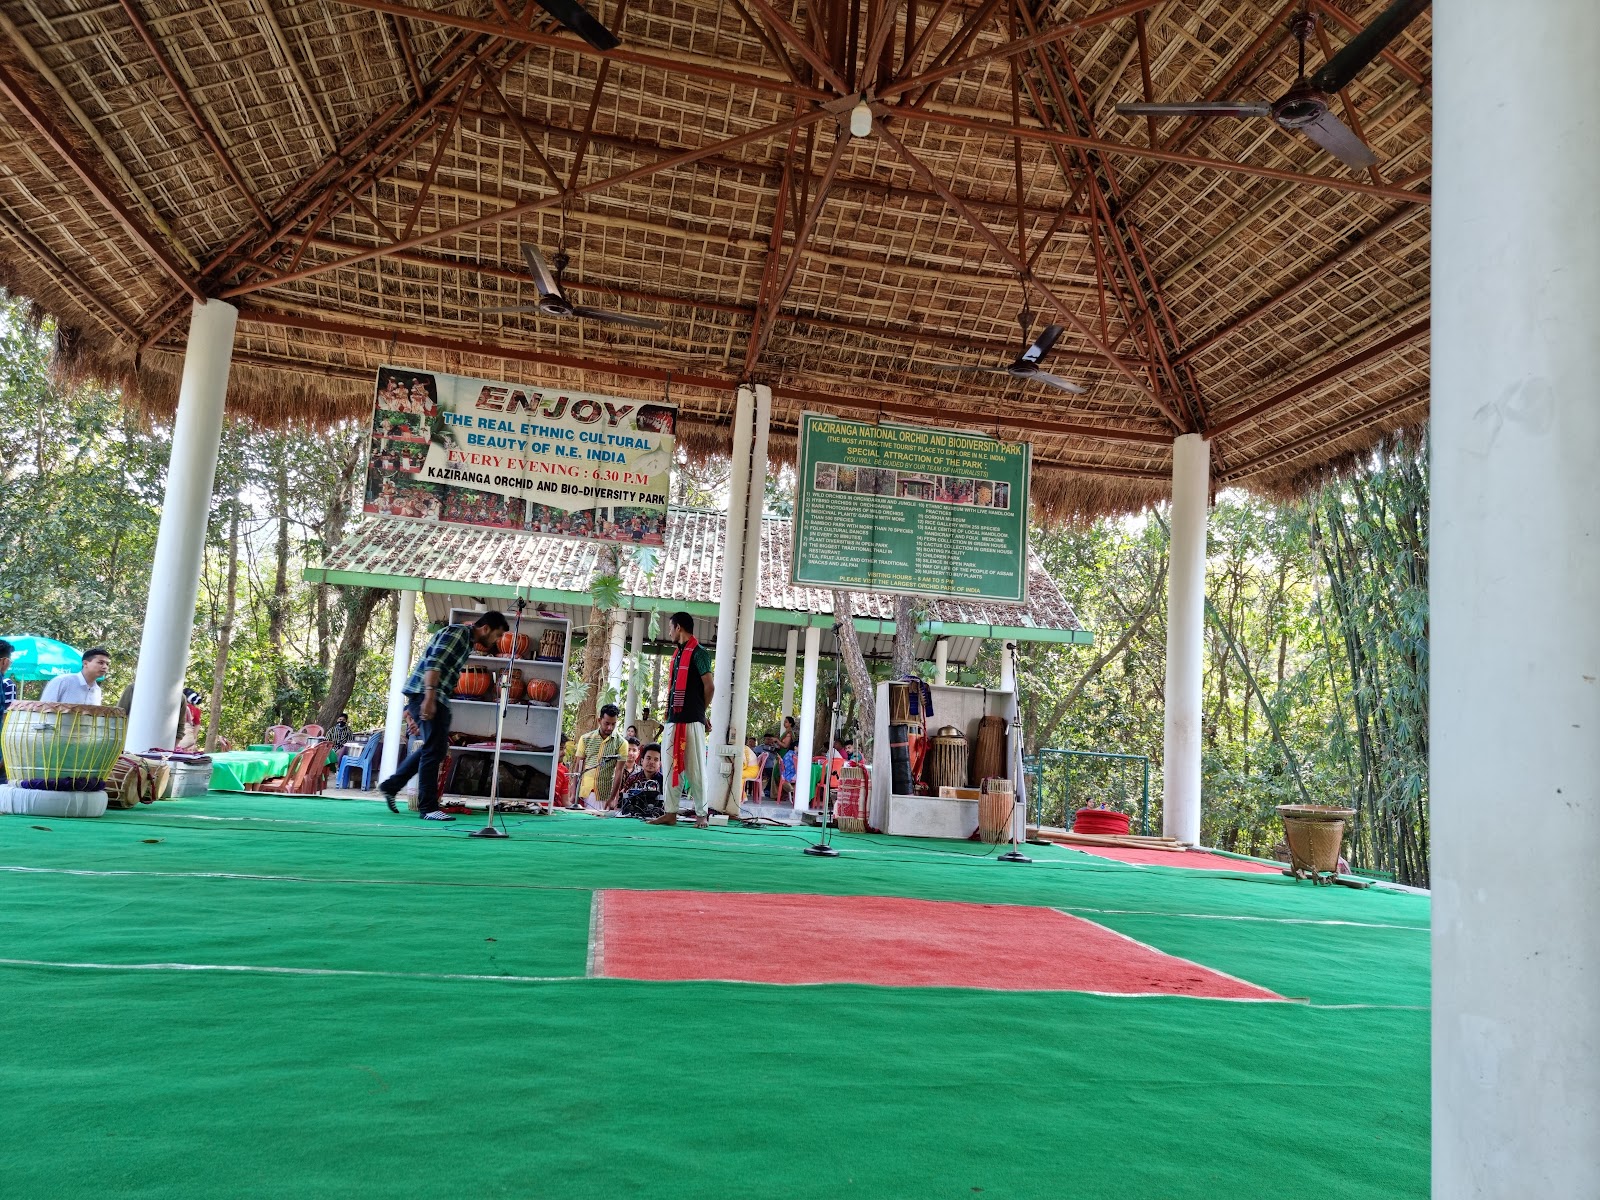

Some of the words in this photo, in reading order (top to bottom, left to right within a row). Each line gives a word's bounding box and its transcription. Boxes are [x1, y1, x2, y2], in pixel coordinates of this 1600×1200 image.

[474, 385, 634, 429] ENJOY
[442, 412, 473, 427] THE
[477, 417, 515, 432] REAL
[520, 422, 574, 440] ETHNIC
[578, 429, 652, 450] CULTURAL
[811, 421, 857, 436] KAZIRANGA
[859, 426, 897, 440] NATIONAL
[899, 431, 928, 444] ORCHID
[930, 434, 946, 446] AND
[949, 437, 999, 452] BIODIVERSITY
[1001, 443, 1021, 454] PARK
[826, 435, 839, 443] (THE
[859, 439, 891, 448] ATTRACTIVE
[893, 443, 916, 451] TOURIST
[945, 449, 970, 457] EXPLORE
[466, 433, 526, 452] BEAUTY
[531, 441, 550, 454] OF
[555, 444, 582, 458] N.E.
[586, 448, 626, 464] INDIA
[847, 446, 879, 457] SPECIAL
[883, 451, 931, 463] ATTRACTION
[945, 458, 960, 466] THE
[962, 459, 982, 468] PARK
[448, 450, 502, 468] EVERY
[506, 457, 579, 477] EVENING
[584, 470, 587, 478] :
[592, 467, 619, 482] 6.30
[623, 471, 648, 485] P.M
[427, 466, 491, 484] KAZIRANGA
[493, 474, 533, 489] ORCHID
[536, 479, 557, 492] AND
[560, 482, 636, 501] BIO-DIVERSITY
[638, 491, 665, 504] PARK
